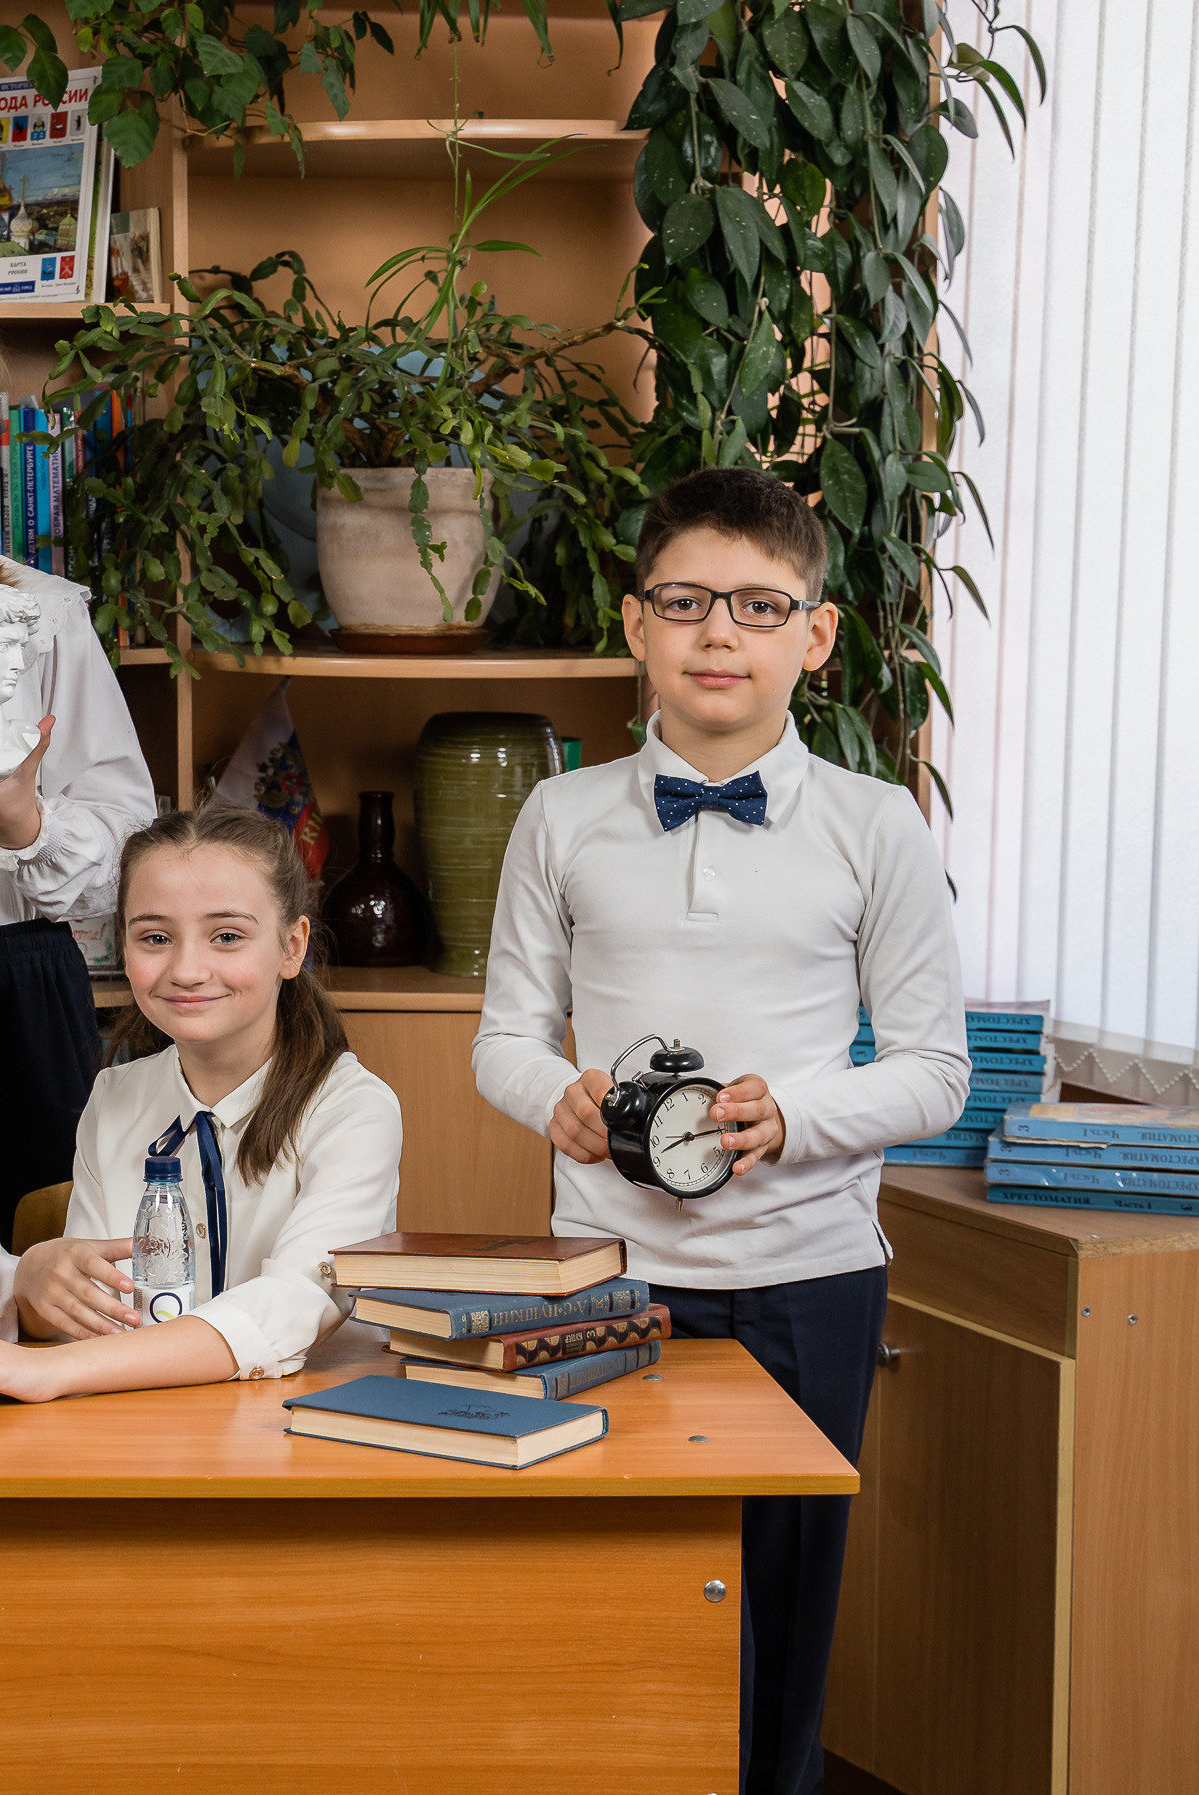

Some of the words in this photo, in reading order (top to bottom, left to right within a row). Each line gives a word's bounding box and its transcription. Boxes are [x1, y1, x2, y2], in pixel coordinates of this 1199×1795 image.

[33, 88, 88, 108] РОСИИ
[26, 445, 35, 518] САНКТ-ПЕТЕРБУРГЕ
[53, 505, 61, 537] ОБРАЯ
[27, 529, 36, 554] ДЕТЯМ
[682, 1092, 689, 1103] 1
[698, 1093, 707, 1105] 2
[654, 1115, 664, 1129] 11
[650, 1135, 661, 1149] 10
[713, 1146, 721, 1157] 5
[652, 1156, 661, 1168] 9
[701, 1162, 709, 1174] 6
[666, 1168, 675, 1179] 8
[684, 1169, 691, 1180] 7
[586, 1330, 596, 1339] 3
